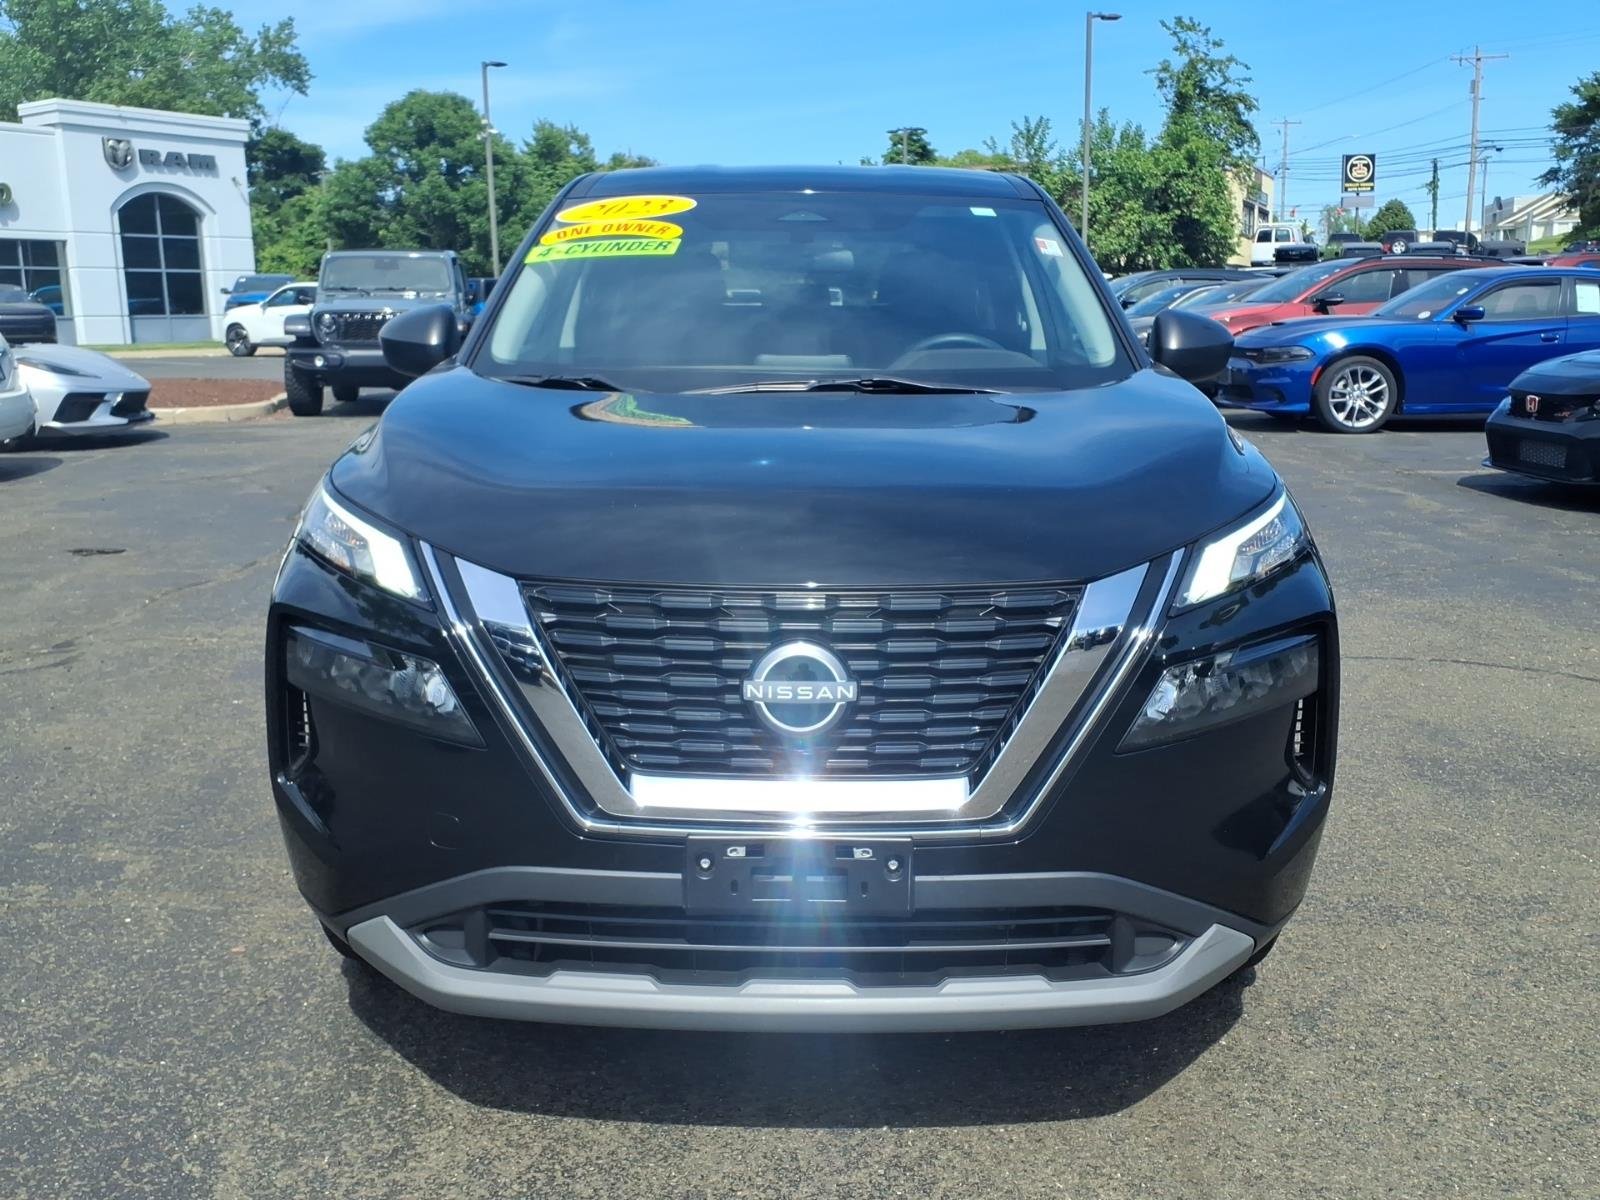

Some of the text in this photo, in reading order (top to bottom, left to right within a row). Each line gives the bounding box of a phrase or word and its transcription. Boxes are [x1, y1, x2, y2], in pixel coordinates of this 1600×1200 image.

[138, 148, 216, 171] RAM
[556, 223, 672, 240] ONE OWNER
[537, 240, 673, 257] 4-CYLINDER
[746, 684, 854, 700] NISSAN
